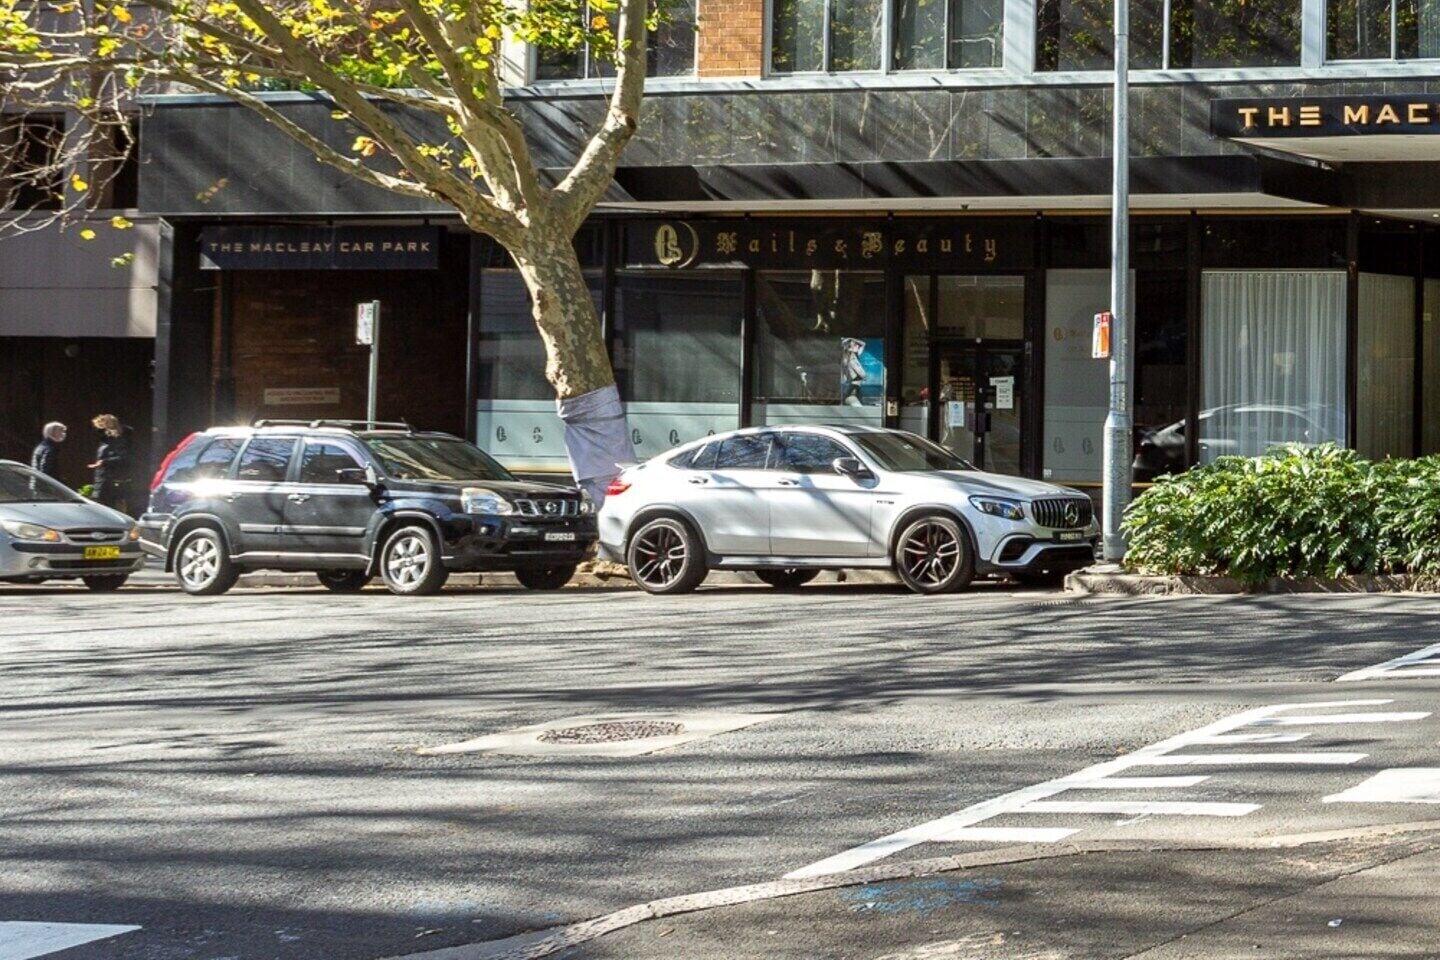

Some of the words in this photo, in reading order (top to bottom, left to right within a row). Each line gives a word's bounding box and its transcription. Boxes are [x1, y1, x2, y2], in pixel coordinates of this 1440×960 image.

[1238, 106, 1321, 127] THE
[210, 242, 243, 253] THE
[250, 242, 332, 253] MACLEAY
[340, 241, 374, 252] CAR
[382, 241, 430, 252] PARK
[716, 230, 818, 256] Nails
[834, 236, 848, 258] &
[861, 232, 996, 262] Beauty
